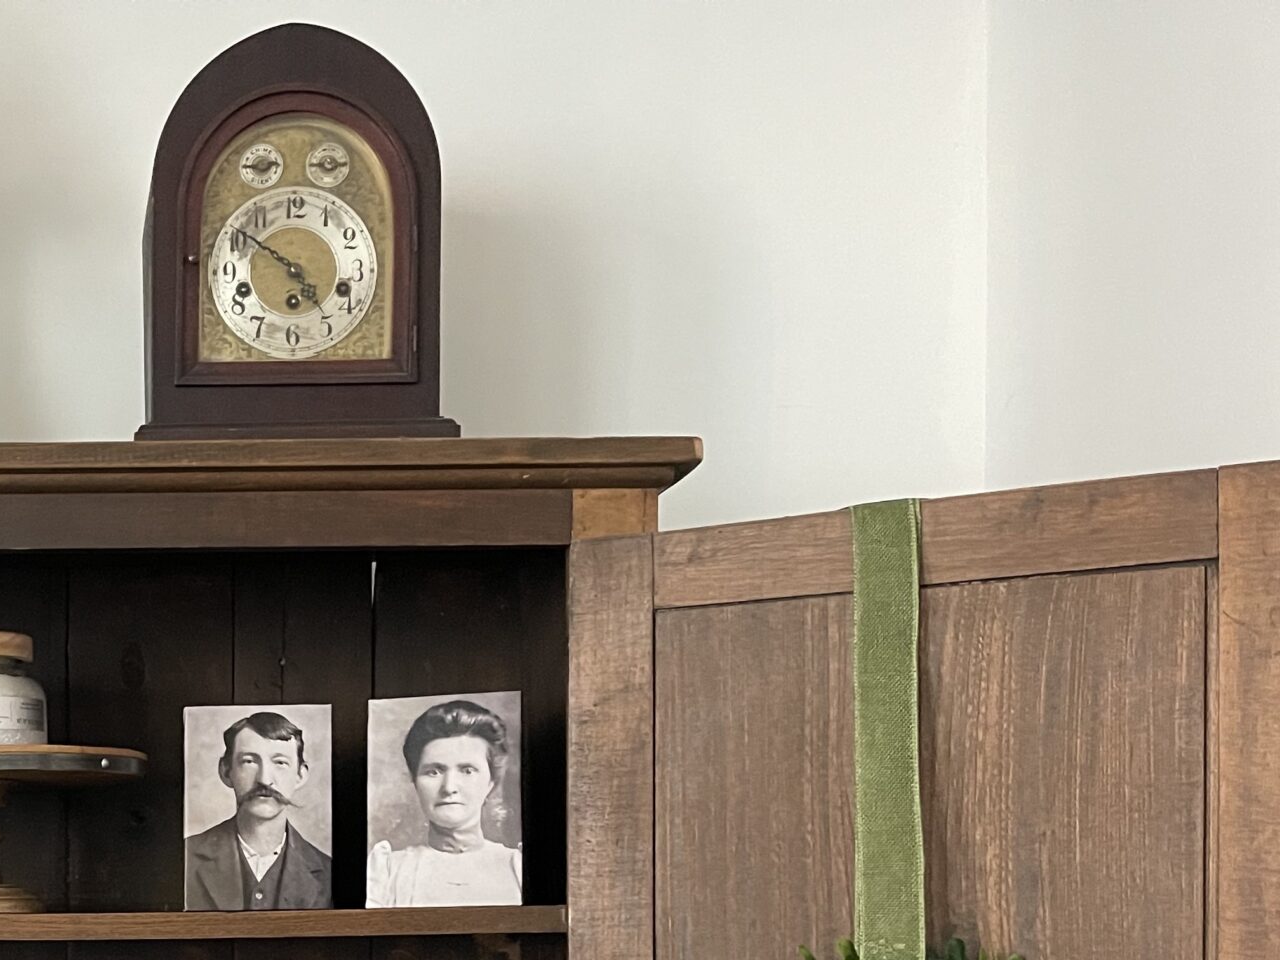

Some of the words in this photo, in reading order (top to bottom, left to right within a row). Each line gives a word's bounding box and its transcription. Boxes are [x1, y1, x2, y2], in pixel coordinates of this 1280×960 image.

[254, 206, 266, 228] 11
[286, 196, 307, 219] 12
[320, 204, 328, 227] 1
[230, 229, 247, 252] 10
[343, 227, 358, 250] 2
[223, 261, 236, 283] 9
[351, 259, 364, 282] 3
[231, 294, 246, 315] 8
[338, 294, 358, 314] 4
[250, 315, 265, 338] 7
[285, 323, 300, 347] 6
[320, 314, 333, 338] 5
